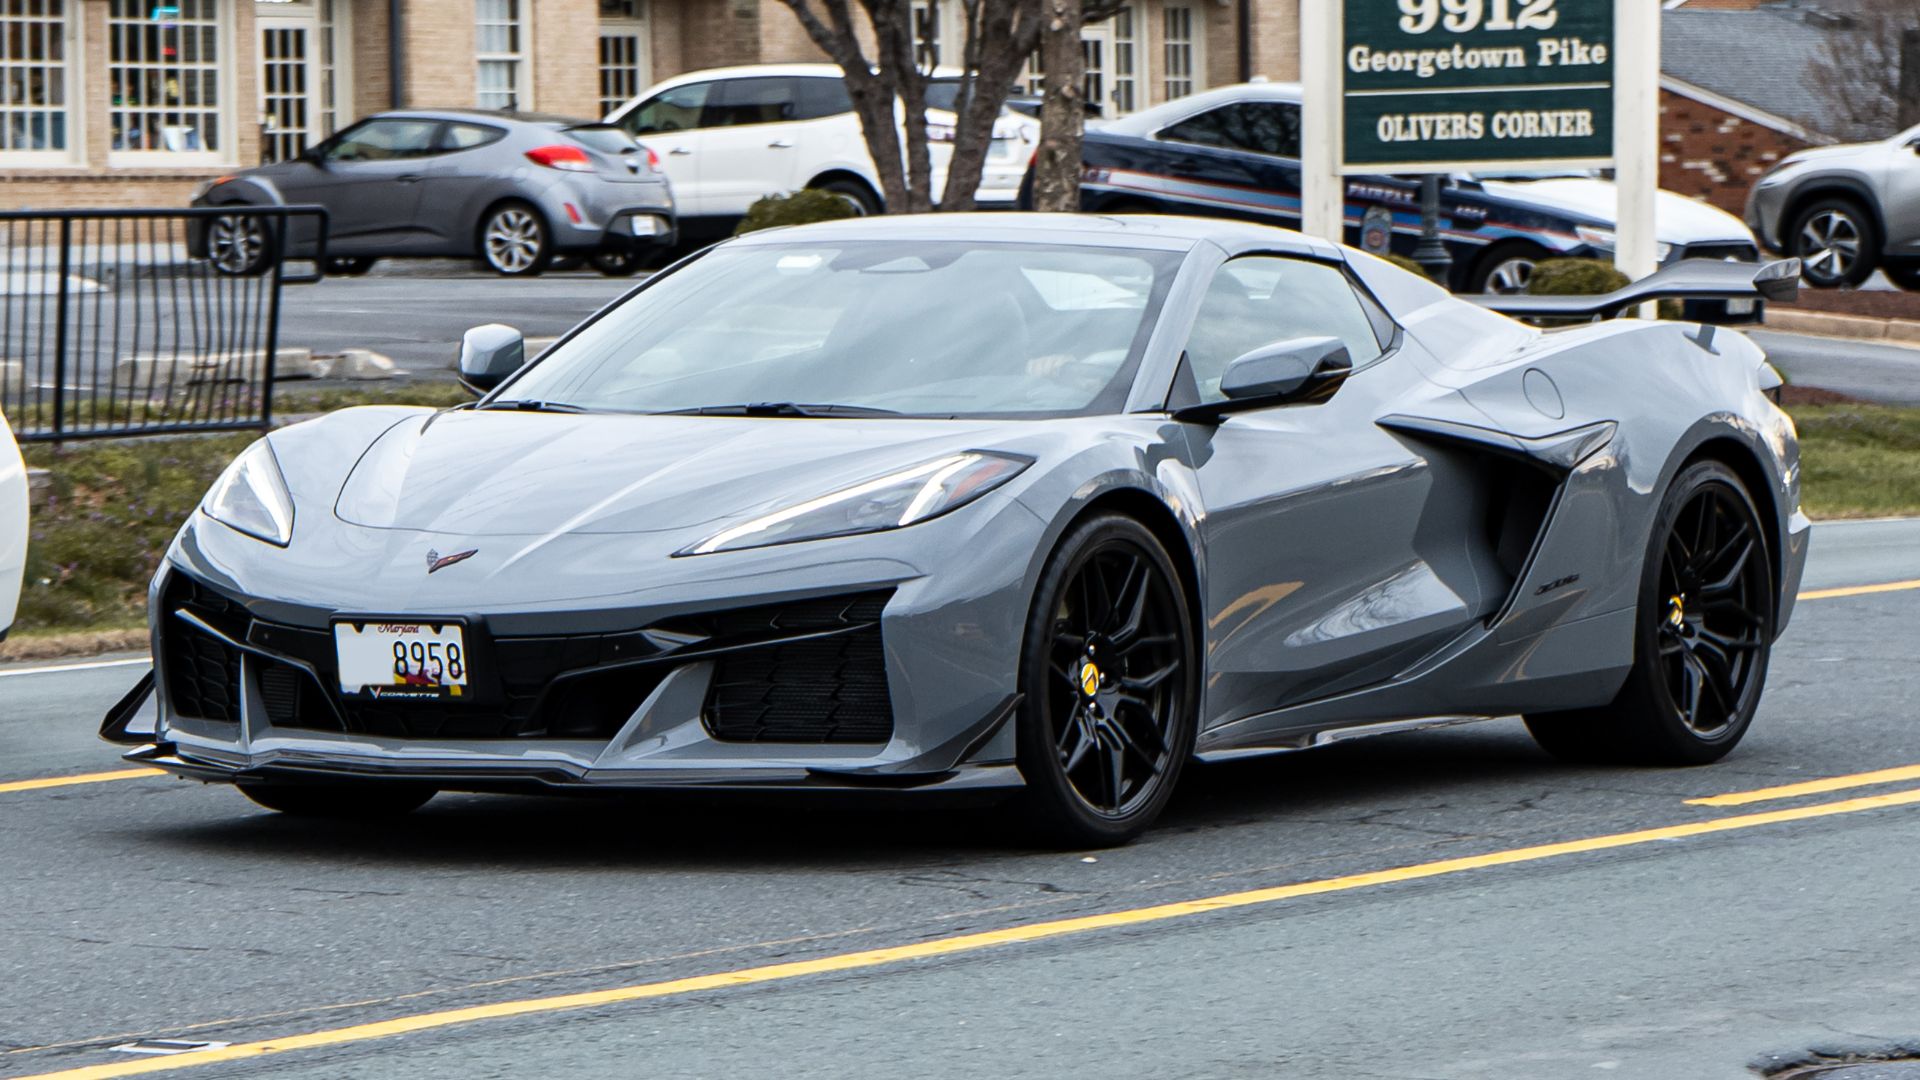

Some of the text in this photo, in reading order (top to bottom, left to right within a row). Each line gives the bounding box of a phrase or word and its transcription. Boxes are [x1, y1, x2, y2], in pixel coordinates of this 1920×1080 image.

[1398, 0, 1558, 34] 9912
[1348, 37, 1608, 78] Georgetown Pike
[1376, 110, 1594, 142] OLIVERS CORNER
[393, 640, 463, 680] 8958
